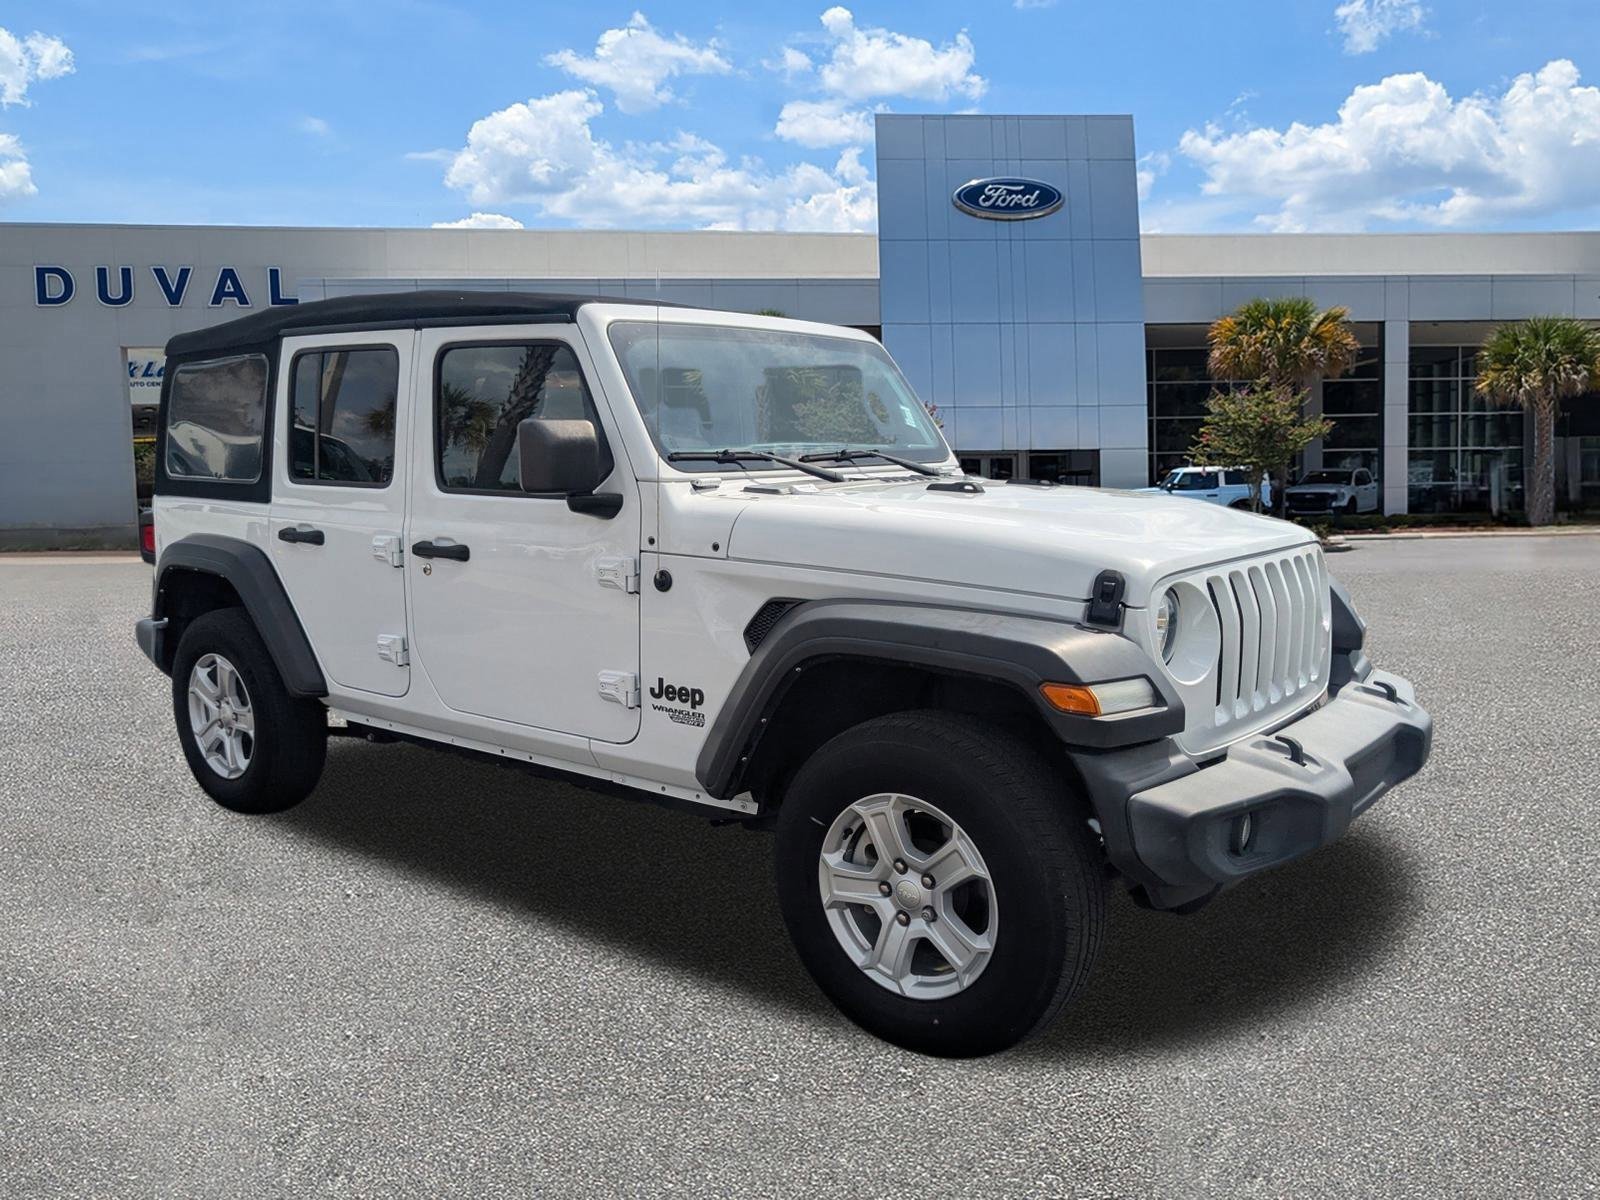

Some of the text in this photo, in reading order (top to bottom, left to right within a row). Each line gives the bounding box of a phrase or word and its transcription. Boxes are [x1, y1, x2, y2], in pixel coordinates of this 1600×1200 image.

[978, 184, 1040, 207] Ford
[33, 265, 299, 307] DUVAL
[649, 677, 705, 710] Jeep
[651, 703, 705, 719] WRANGLER
